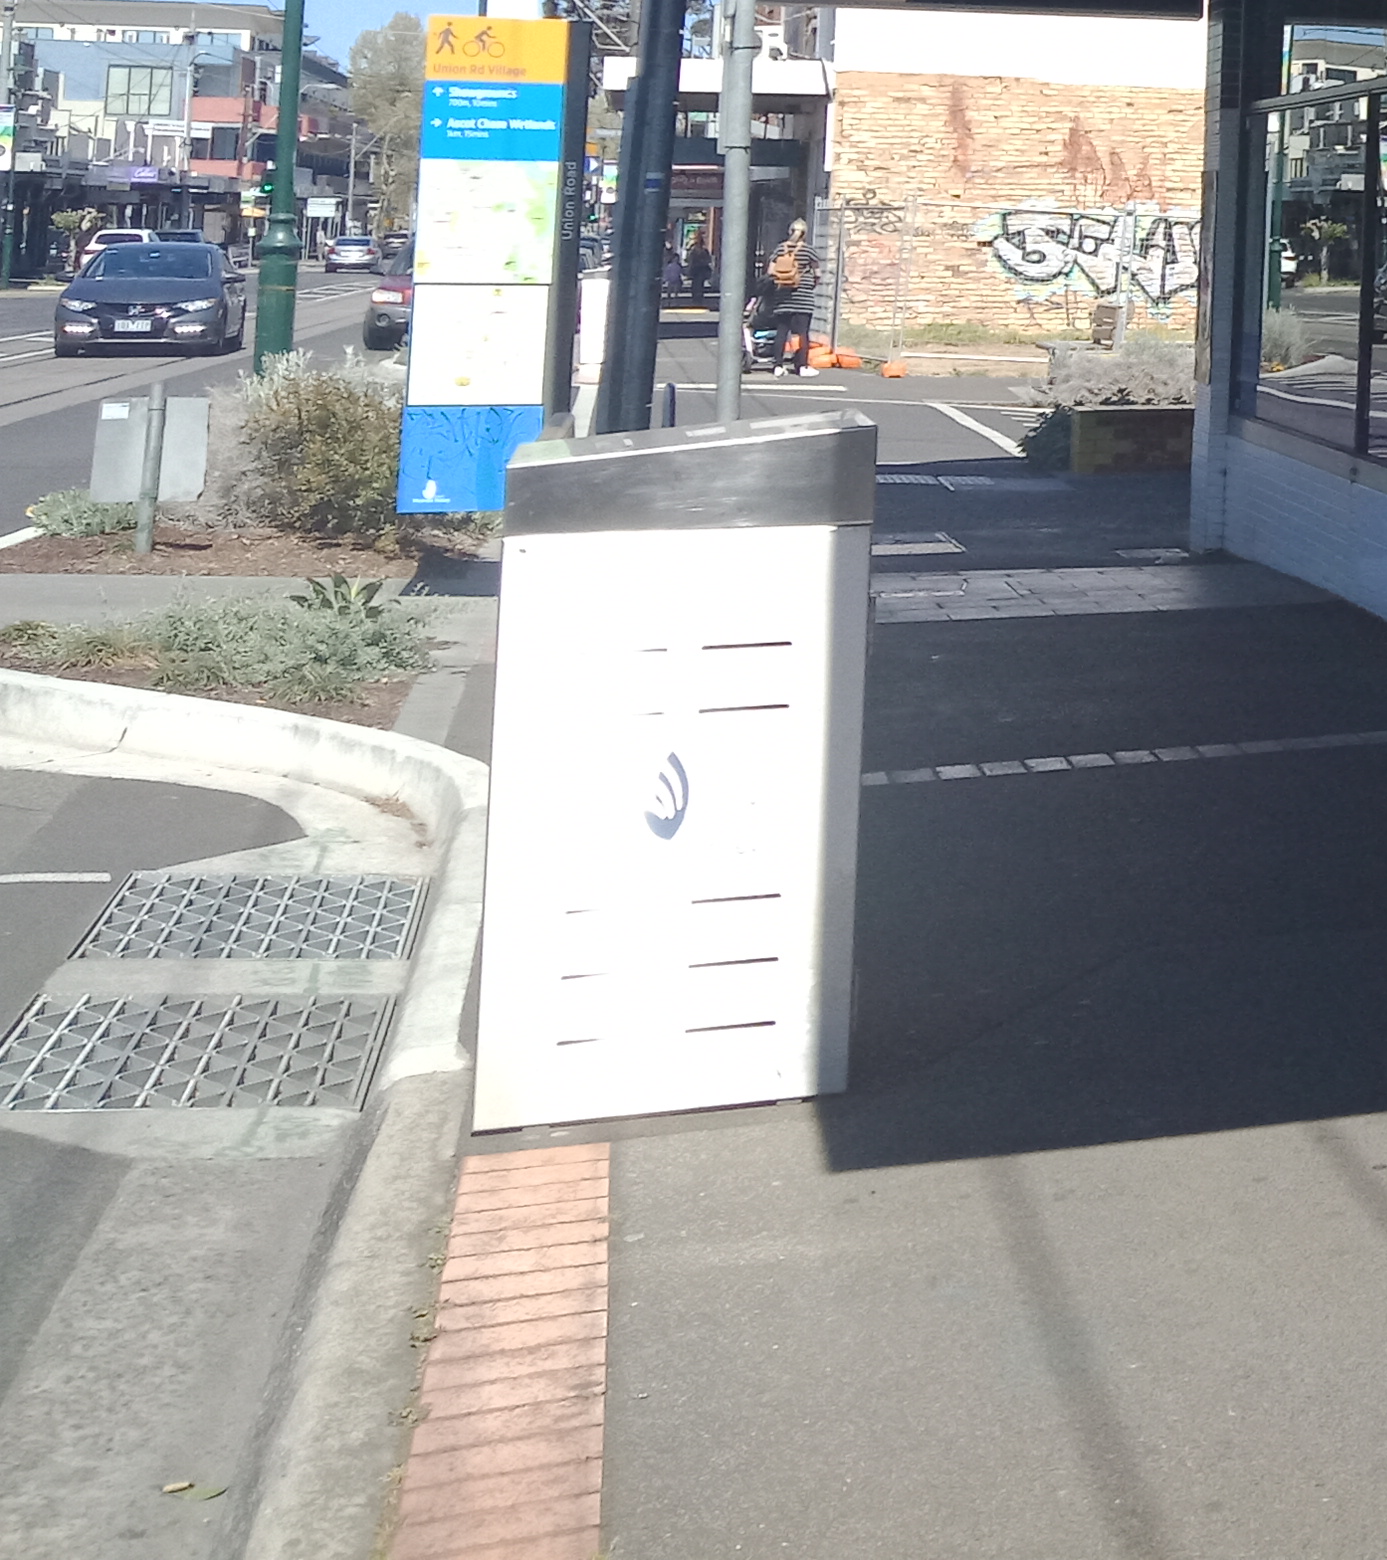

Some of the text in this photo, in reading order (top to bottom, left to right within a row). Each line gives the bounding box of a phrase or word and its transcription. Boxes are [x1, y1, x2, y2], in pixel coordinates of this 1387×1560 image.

[433, 63, 527, 78] Union Rd Village
[561, 161, 577, 241] Union Road
